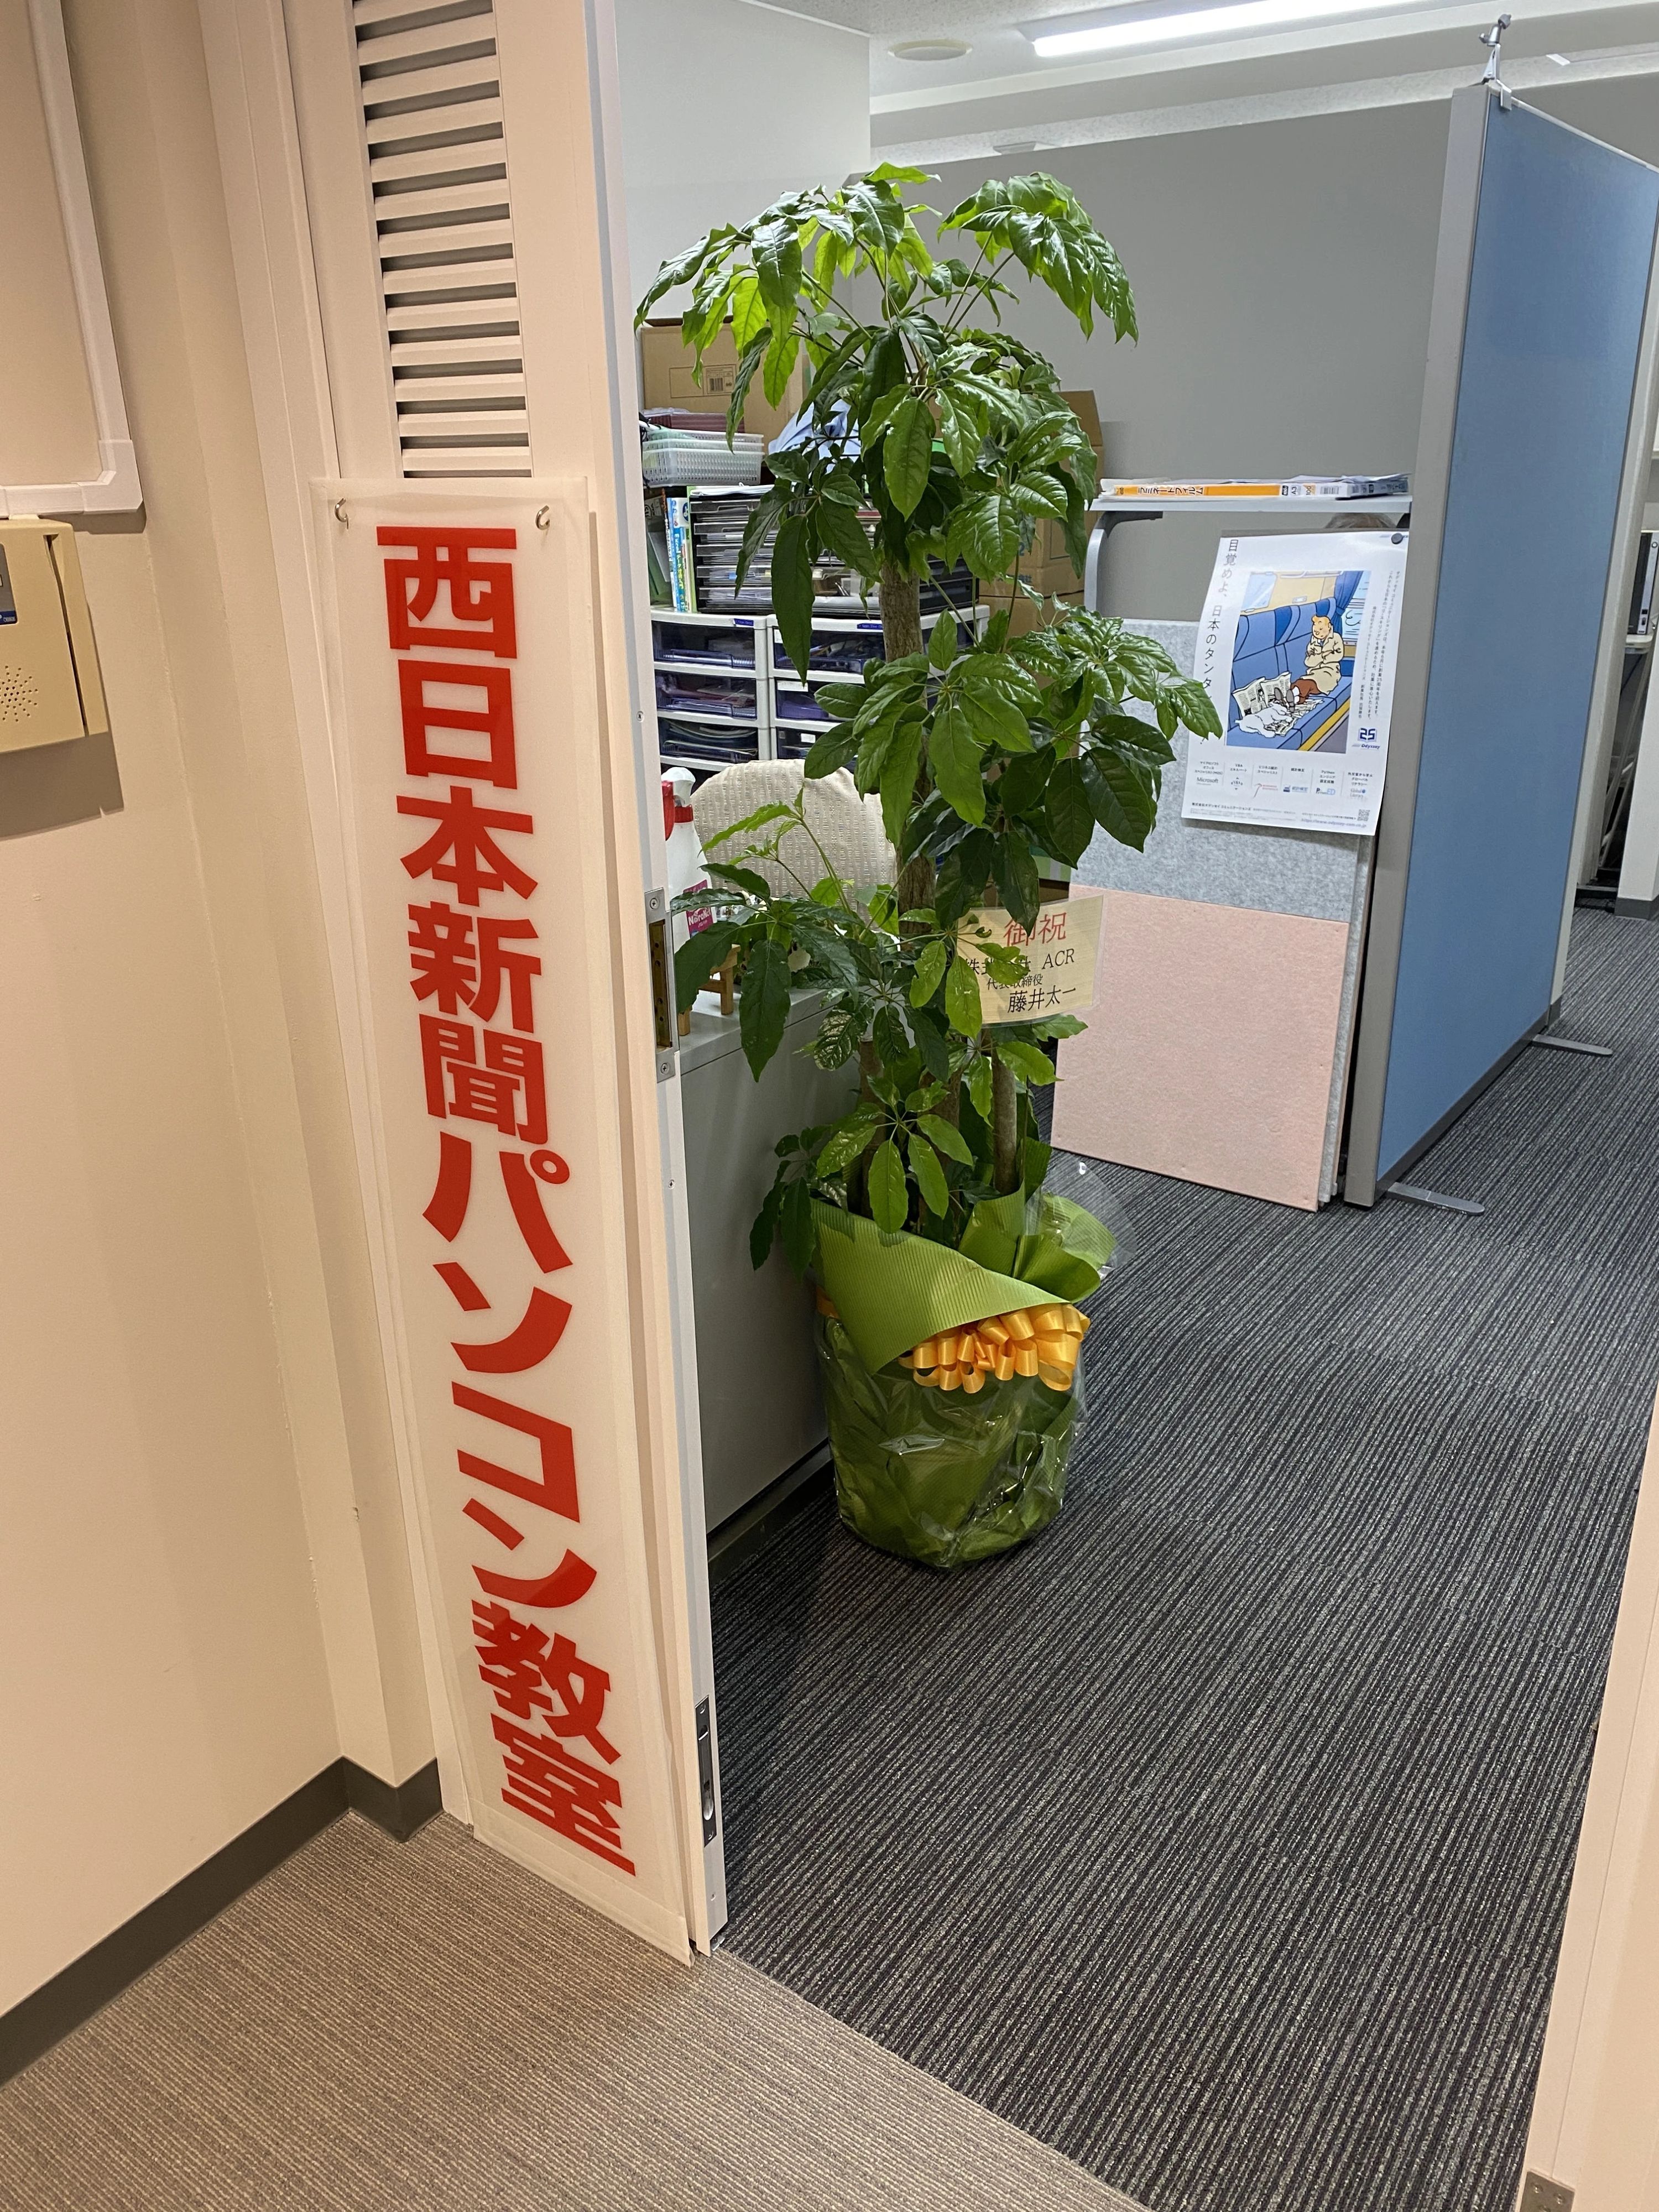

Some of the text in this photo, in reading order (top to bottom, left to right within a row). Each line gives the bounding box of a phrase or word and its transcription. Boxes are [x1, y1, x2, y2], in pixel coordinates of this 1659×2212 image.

[1138, 487, 1203, 495] ラミネートフィルム
[1359, 728, 1376, 740] 25
[1003, 912, 1066, 947] 御祝
[1042, 948, 1074, 969] ACR
[1008, 985, 1076, 1013] 藤井太一
[377, 526, 636, 1877] 西日本新聞パソコン教室
